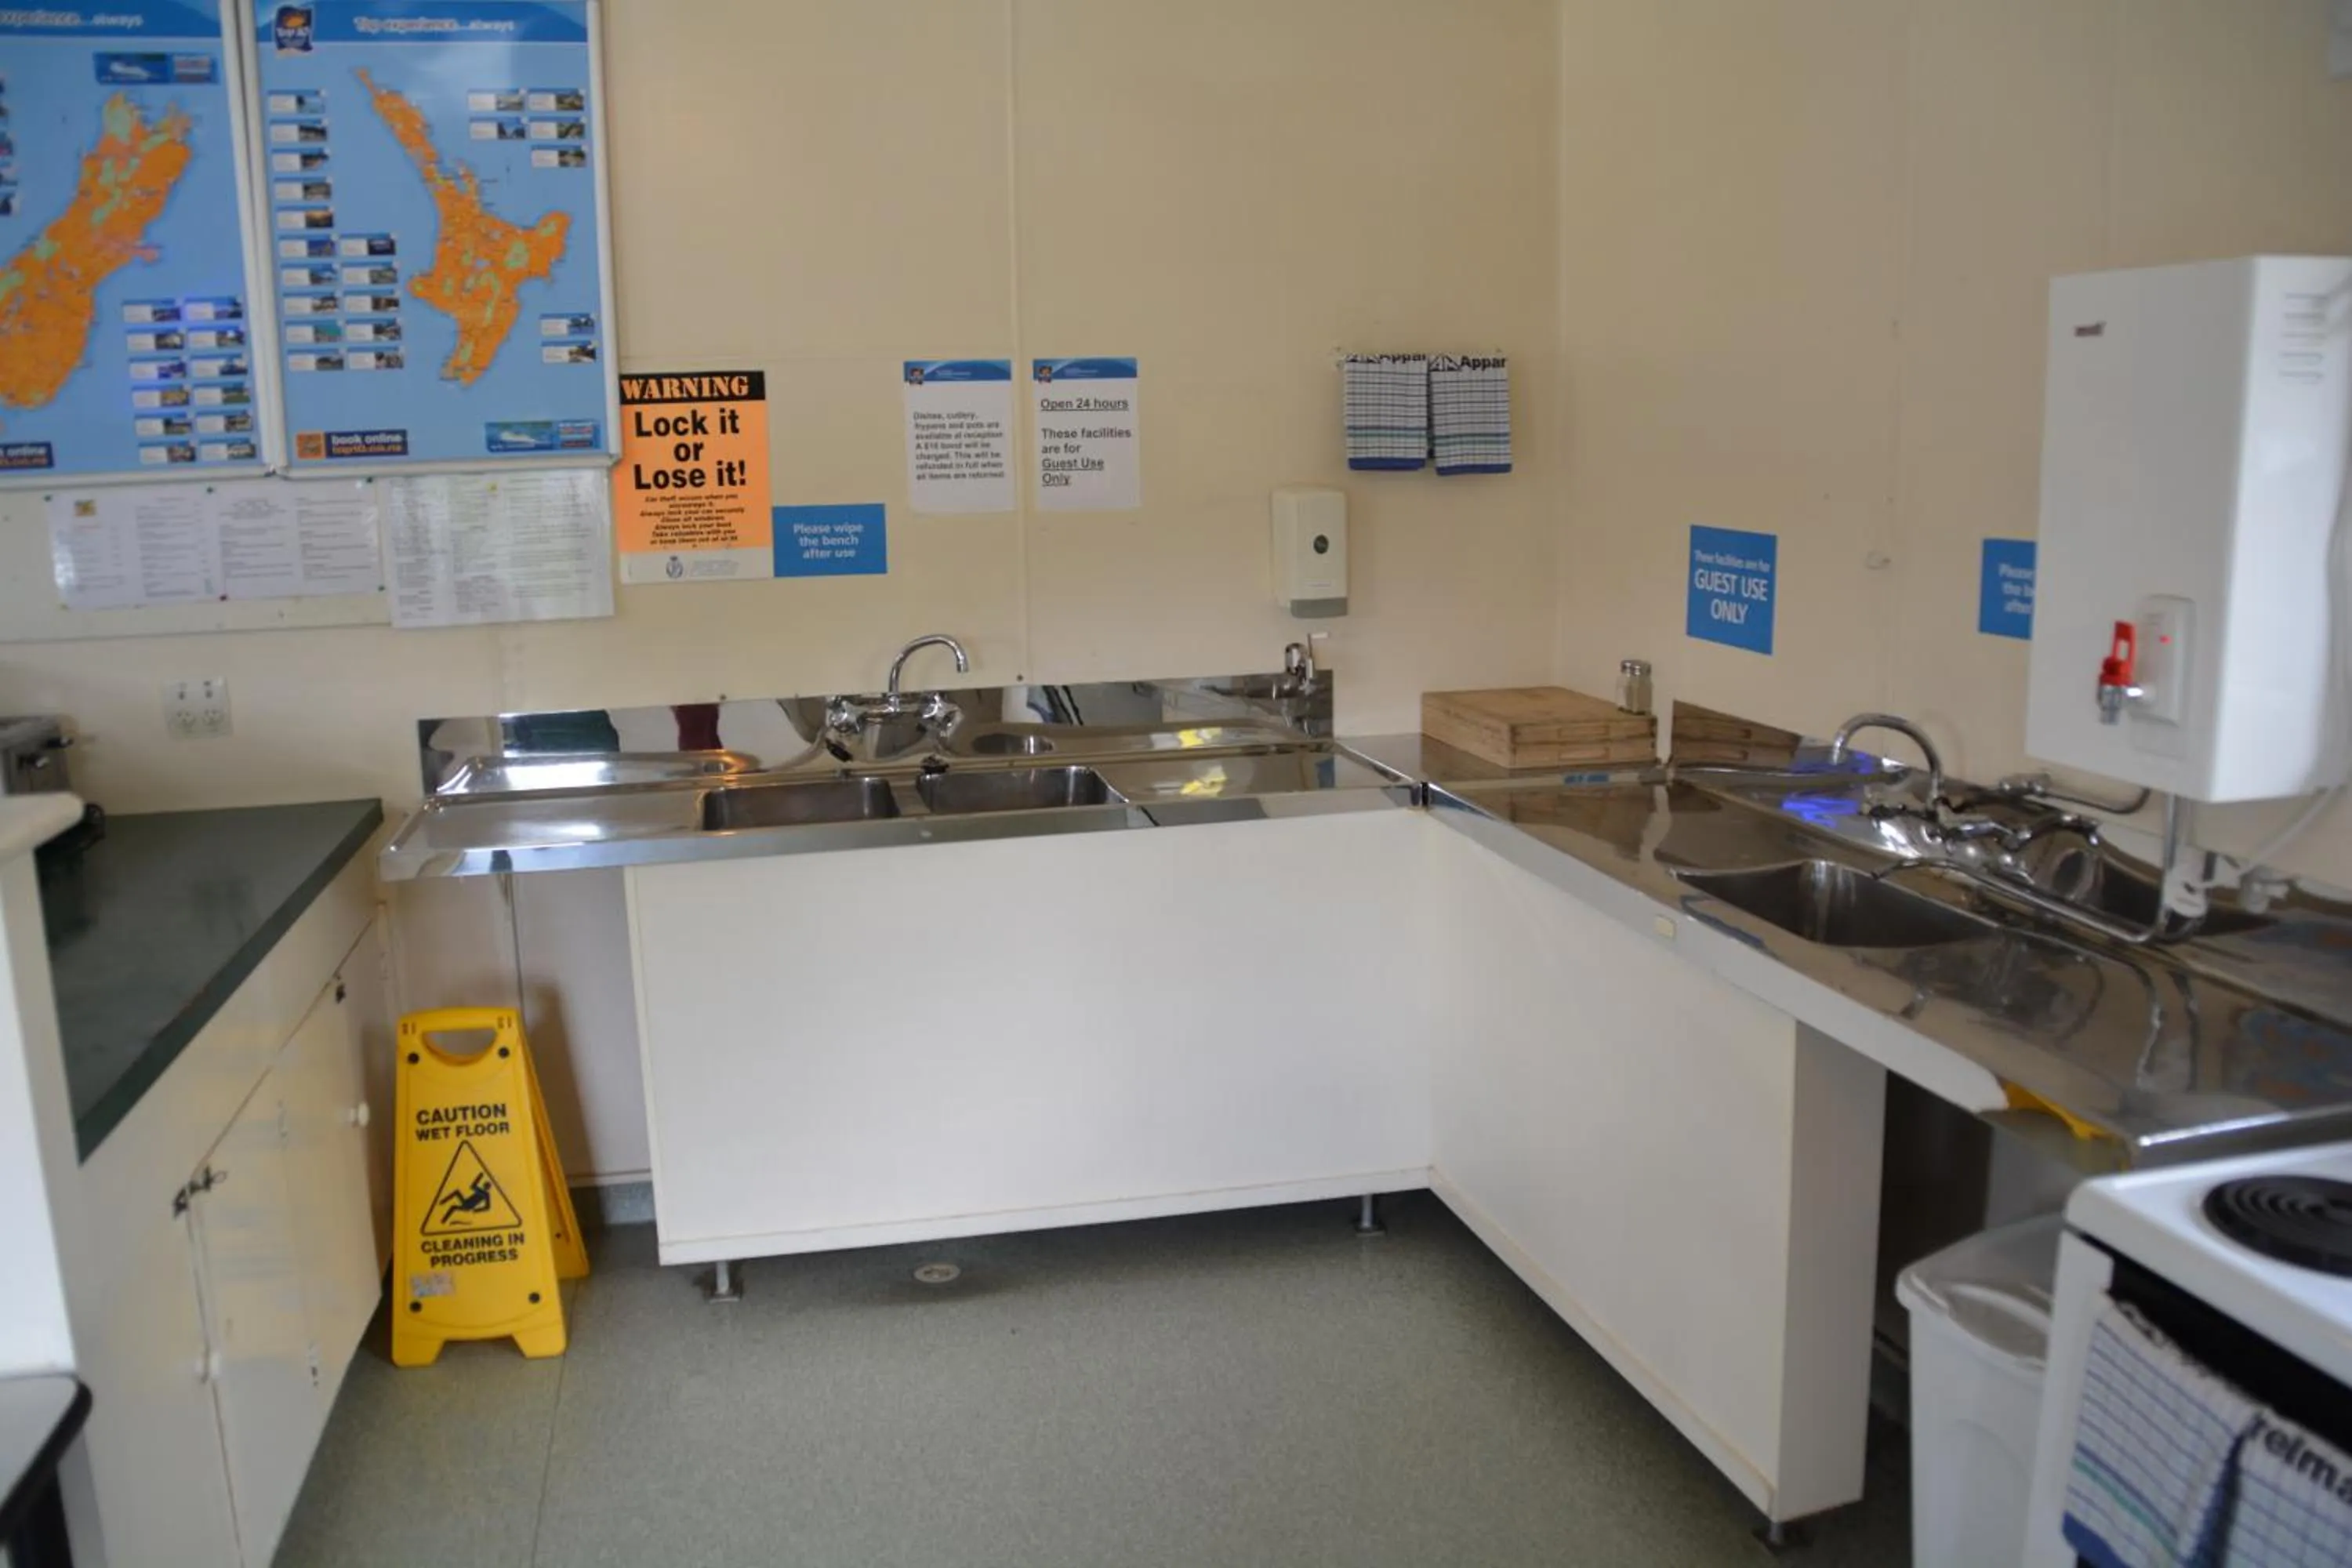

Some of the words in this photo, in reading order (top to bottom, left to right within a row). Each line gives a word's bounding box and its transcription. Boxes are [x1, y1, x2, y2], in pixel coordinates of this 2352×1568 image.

[1460, 356, 1506, 371] Appar
[621, 376, 750, 399] WARNING
[1040, 398, 1073, 410] Open
[1076, 398, 1091, 408] 24
[1094, 397, 1129, 408] hours
[635, 409, 709, 437] Lock
[719, 408, 739, 434] it
[1041, 427, 1077, 438] These
[1081, 426, 1131, 438] facilities
[673, 442, 704, 462] or
[1042, 445, 1060, 454] are
[1064, 443, 1081, 454] for
[1042, 458, 1077, 469] Guest
[1081, 457, 1104, 469] Use
[633, 464, 706, 490] Lose
[717, 459, 746, 487] it!
[1042, 473, 1070, 486] Only
[793, 523, 831, 534] Please
[833, 522, 864, 534] wipe
[799, 536, 818, 547] the
[822, 535, 859, 546] bench
[803, 548, 831, 559] after
[834, 549, 855, 558] use
[1694, 568, 1737, 595] GUEST
[1741, 575, 1769, 601] USE
[1710, 598, 1748, 625] ONLY
[416, 1103, 506, 1125] CAUTION
[416, 1127, 450, 1142] WET
[456, 1122, 510, 1138] FLOOR
[421, 1234, 504, 1254] CLEANING
[509, 1233, 525, 1245] IN
[430, 1249, 518, 1269] PROGRESS
